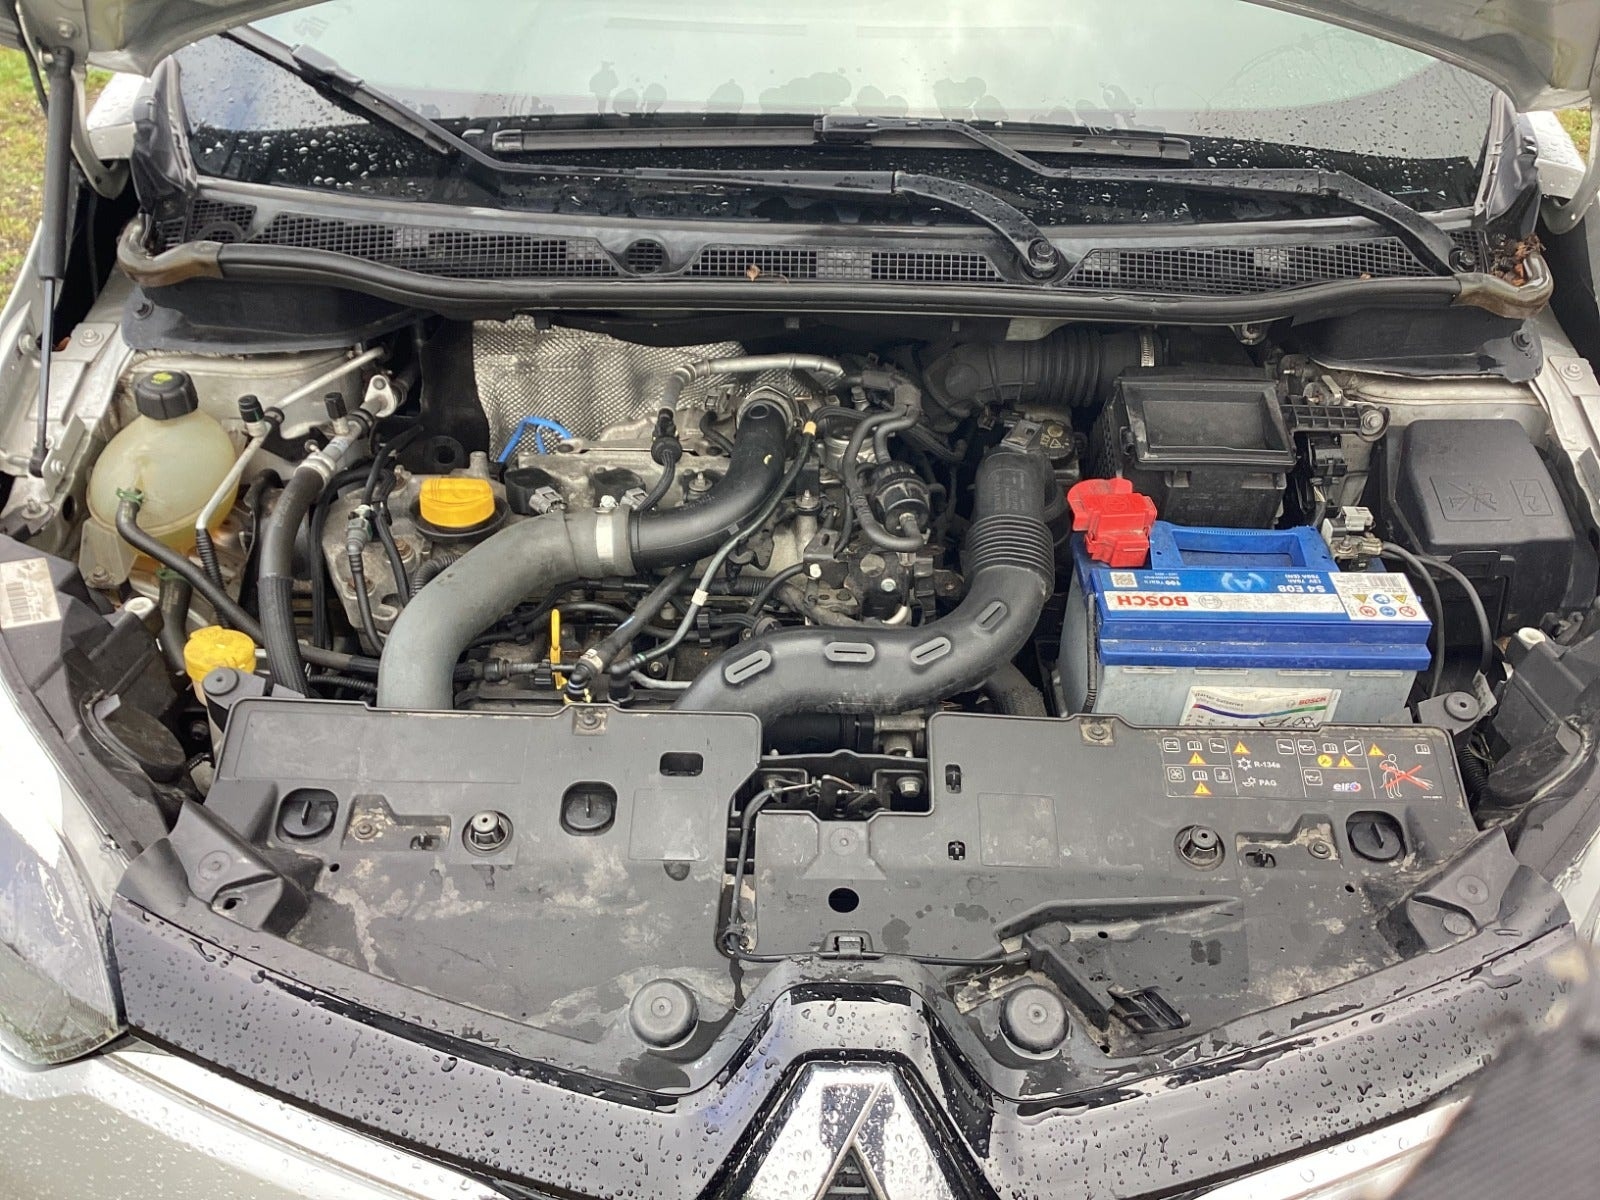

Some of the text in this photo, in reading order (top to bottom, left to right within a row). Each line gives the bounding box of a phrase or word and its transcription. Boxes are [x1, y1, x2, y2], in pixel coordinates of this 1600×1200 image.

[1277, 584, 1326, 593] S4 E08
[1116, 595, 1189, 607] BOSCH
[1298, 696, 1327, 706] BOSCH
[1333, 782, 1351, 792] elf
